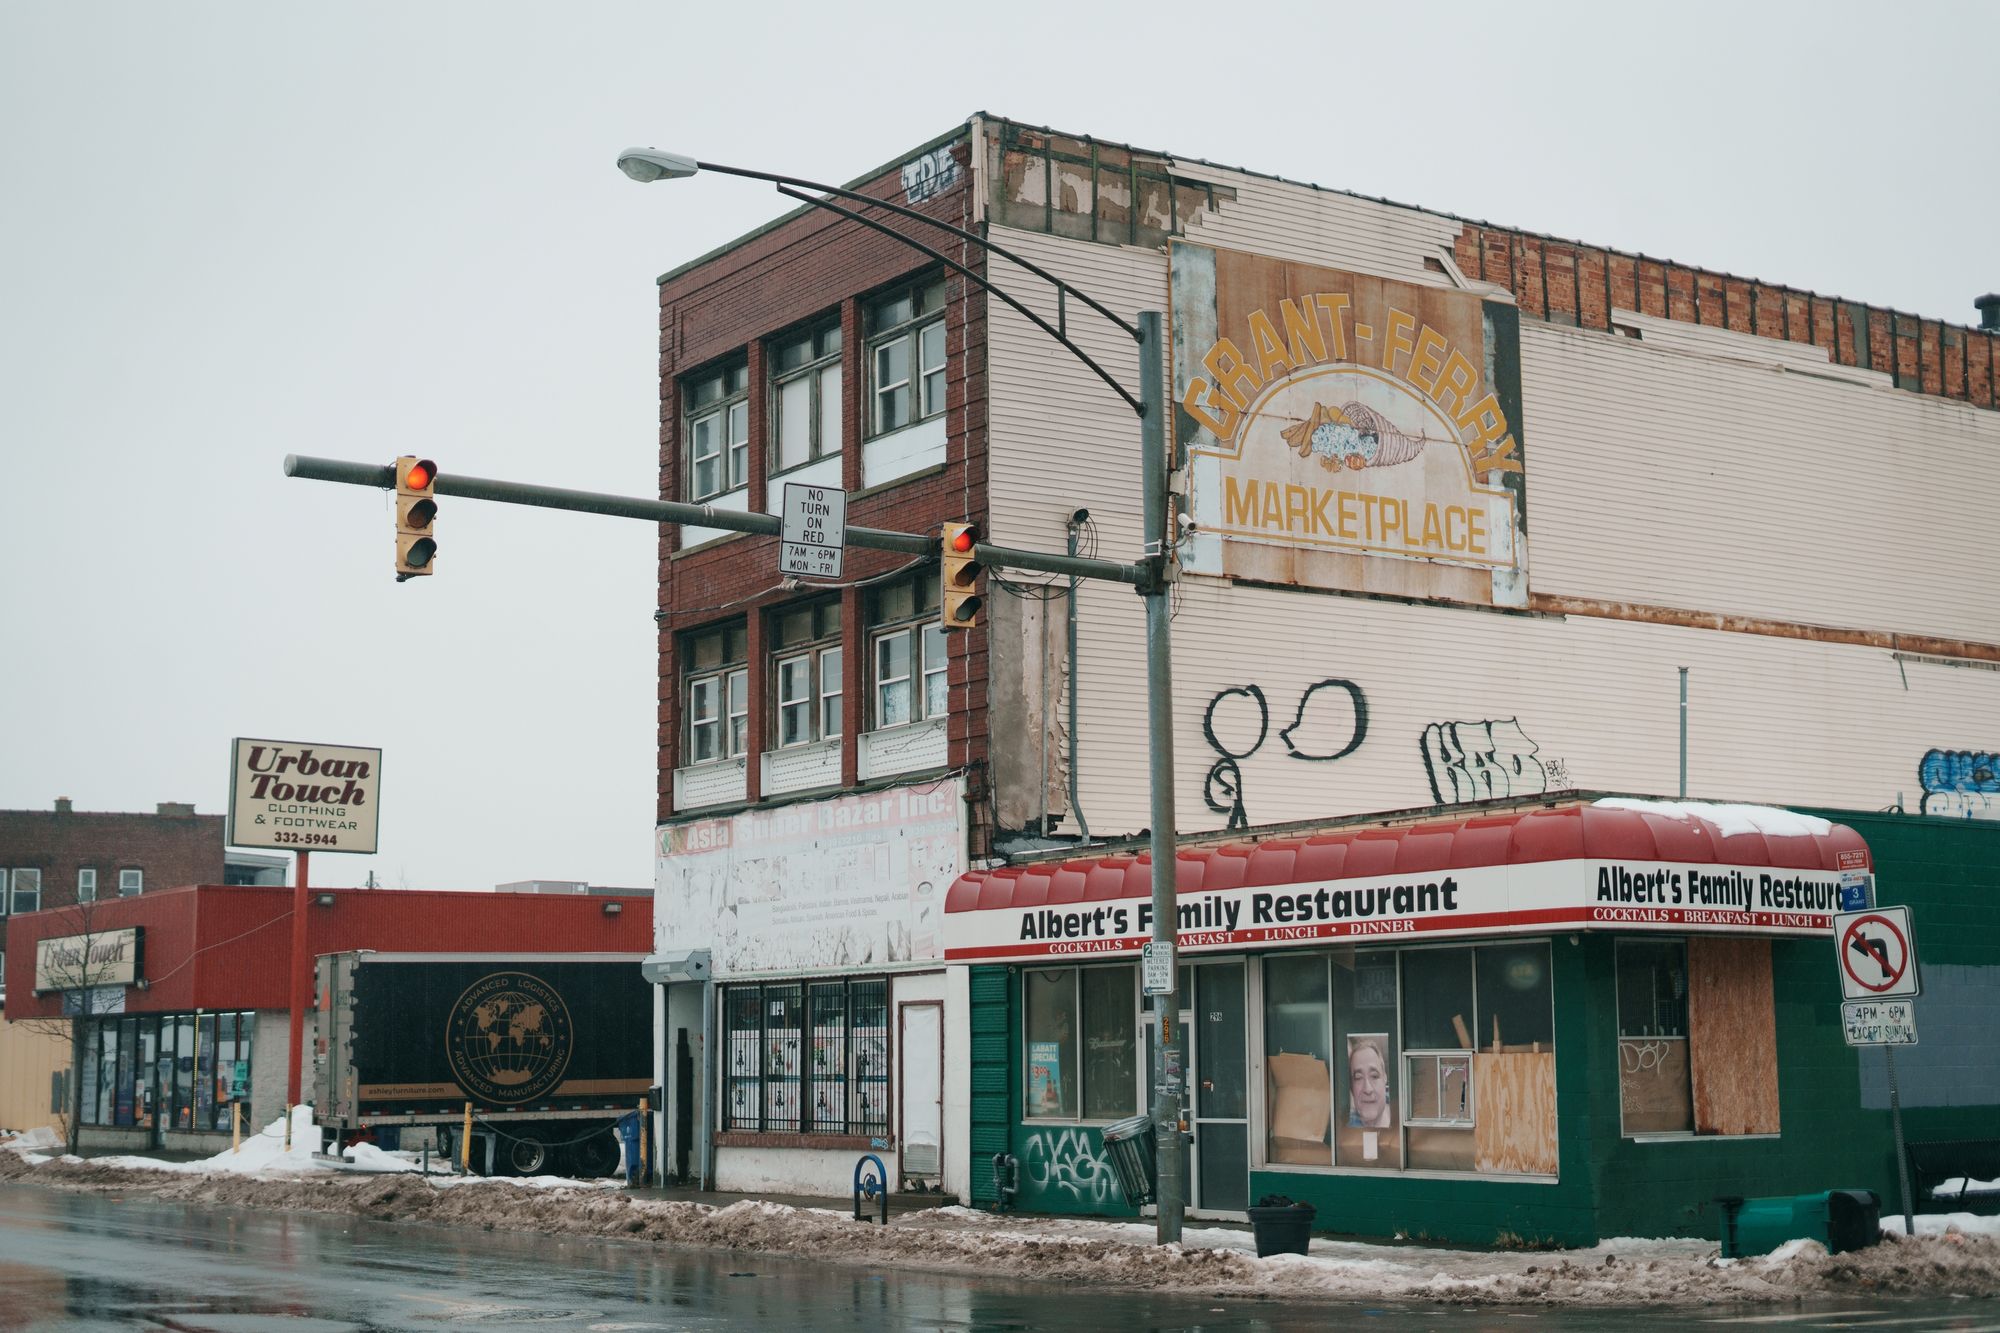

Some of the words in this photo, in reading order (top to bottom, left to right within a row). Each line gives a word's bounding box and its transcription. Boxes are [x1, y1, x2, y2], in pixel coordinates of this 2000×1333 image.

[808, 489, 824, 501] NO
[801, 502, 830, 516] TURN
[1225, 476, 1486, 554] MARKETPLACE
[807, 517, 822, 529] ON
[803, 530, 825, 543] RED
[789, 546, 807, 557] 7AM
[818, 550, 836, 560] 6PM
[789, 560, 809, 570] MON
[820, 563, 833, 573] FRI
[248, 746, 370, 779] Urban
[250, 774, 365, 806] Touch
[268, 804, 346, 817] CLOTHING
[255, 815, 266, 825] &
[274, 817, 357, 830] FOOTWEAR
[686, 824, 729, 850] Asia
[817, 797, 893, 830] Bazar
[899, 791, 953, 820] Inc.
[274, 832, 338, 845] 332-5944
[1597, 866, 1682, 904] Albert's
[1688, 870, 1754, 912] Family
[1852, 888, 1860, 898] 3
[1020, 906, 1128, 940] Albert's
[1138, 895, 1241, 932] Fmily
[1252, 877, 1458, 924] Restaurant
[1593, 907, 1669, 922] COCKTAILS
[1684, 911, 1758, 925] BREAKFAST
[1771, 913, 1813, 927] LUNCH
[1049, 940, 1123, 954] COCKTAILS
[1264, 926, 1318, 940] LUNCH
[1350, 920, 1415, 935] DINNER
[1145, 944, 1152, 957] 2
[461, 979, 509, 1013] ADVANCED
[518, 980, 560, 1013] LOGISTICS
[1856, 1007, 1878, 1020] 4PM
[1889, 1006, 1906, 1019] 6PM
[1852, 1026, 1882, 1040] EXCEPT
[1885, 1025, 1911, 1038] SUNDAY
[1031, 1044, 1057, 1053] LABATT
[1031, 1053, 1058, 1062] SPECIAL
[455, 1051, 493, 1094] ADVANCED
[498, 1048, 566, 1097] MANUFACTURING
[368, 1086, 445, 1096] ashleyfurniture.com
